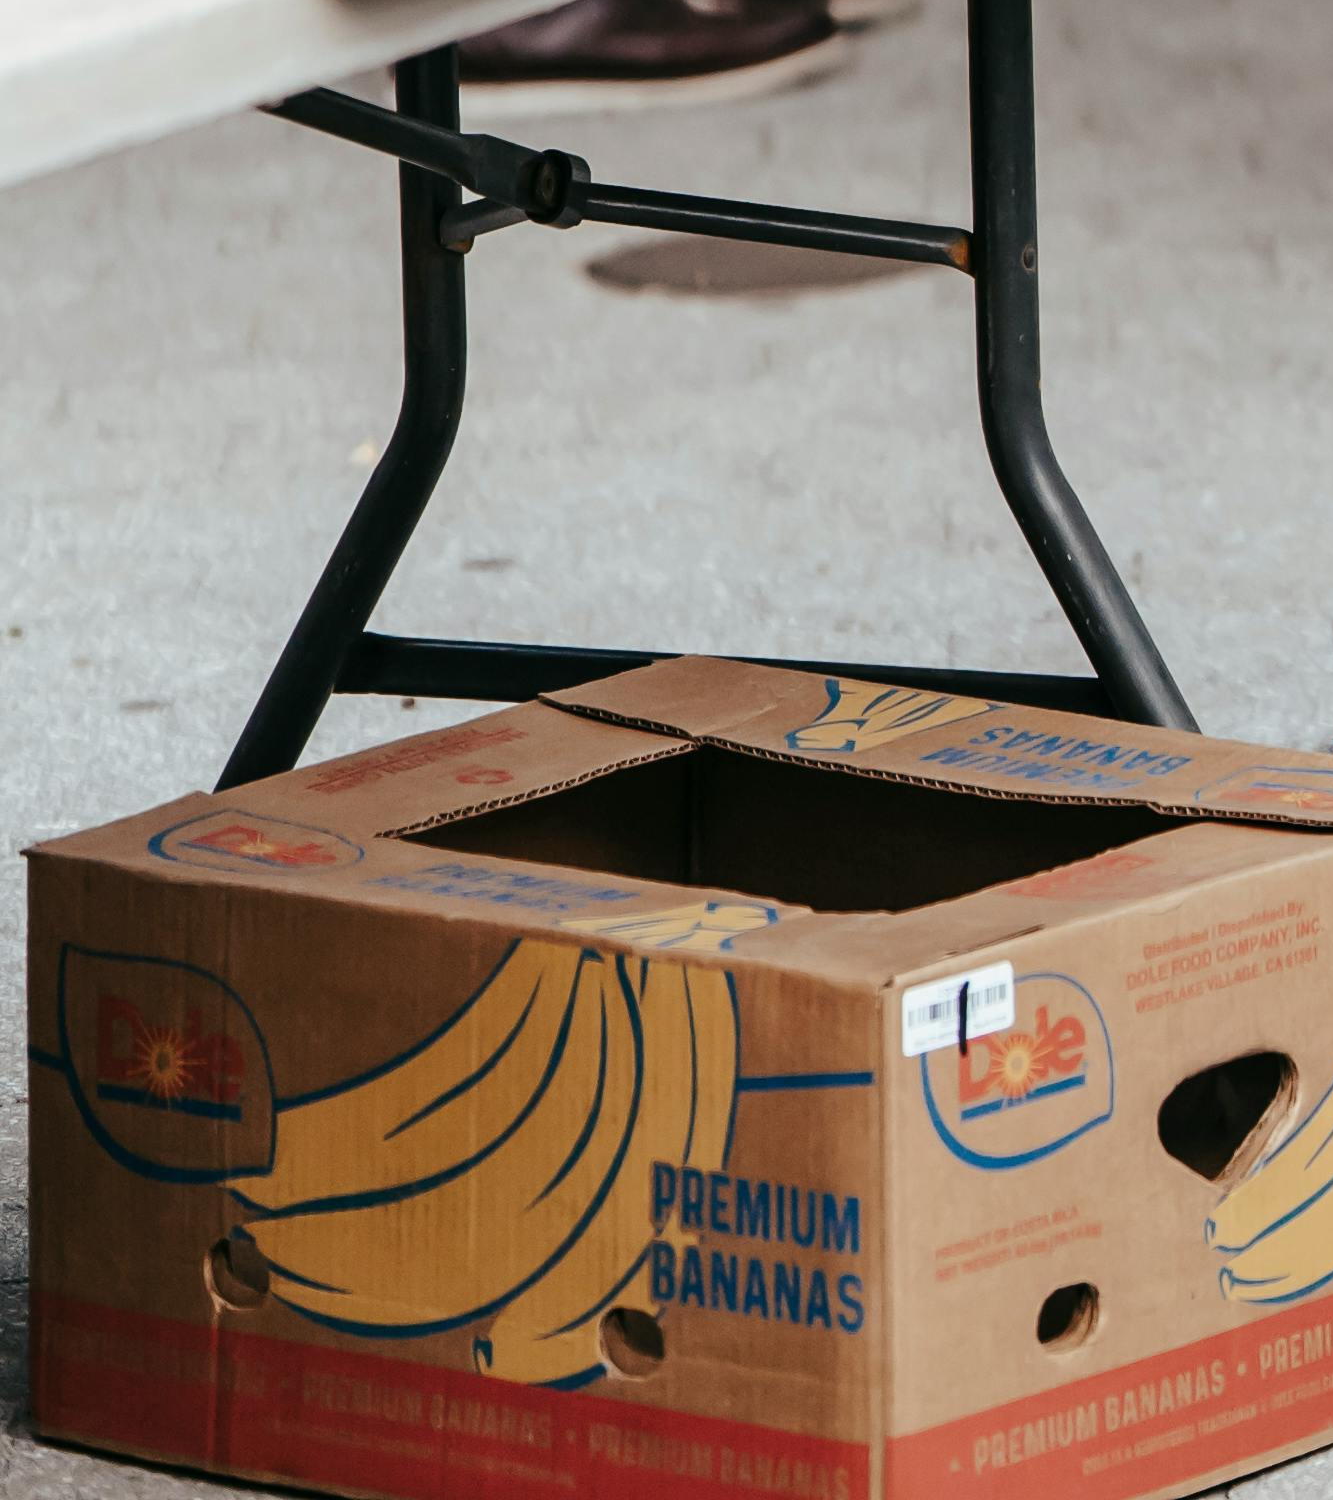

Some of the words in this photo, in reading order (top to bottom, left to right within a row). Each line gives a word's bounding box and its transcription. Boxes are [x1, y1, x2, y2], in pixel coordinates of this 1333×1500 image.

[919, 746, 1144, 790] PREMIUM
[968, 725, 1194, 777] BANANAS
[1126, 963, 1168, 991] DOLE
[1171, 949, 1212, 977] FOOD
[1216, 925, 1292, 963] COMPANY,
[96, 995, 248, 1101] Dole
[958, 1004, 1087, 1104] Dole
[653, 1162, 861, 1254] PREMIUM
[652, 1241, 865, 1334] BANANAS
[588, 1422, 713, 1480] PREMIUM
[719, 1445, 851, 1500] BANANAS
[973, 1400, 1098, 1476] PREMIUM
[1104, 1358, 1226, 1433] BANANAS
